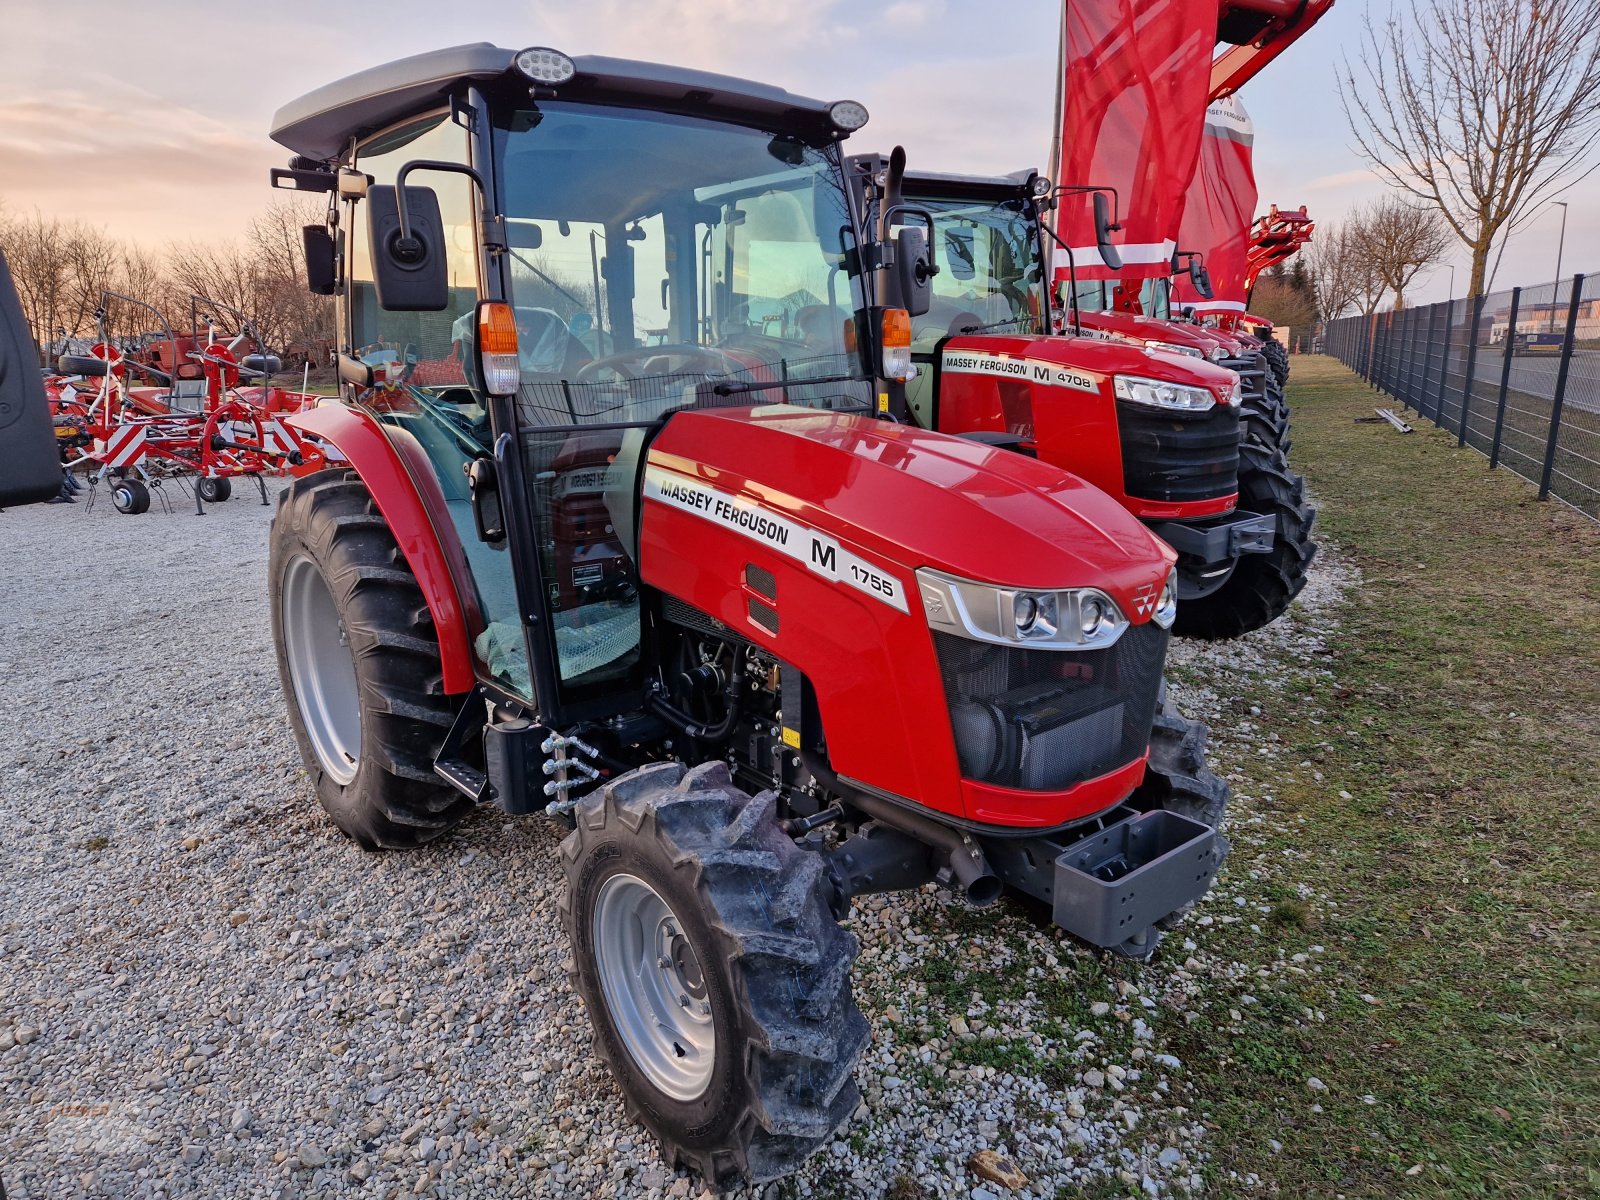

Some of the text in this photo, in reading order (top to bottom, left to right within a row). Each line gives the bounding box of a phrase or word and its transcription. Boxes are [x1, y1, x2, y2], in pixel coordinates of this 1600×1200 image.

[946, 357, 1091, 388] MASSEY FERGUSON M 4708
[660, 479, 895, 598] MASSEY FERGUSON M 1755
